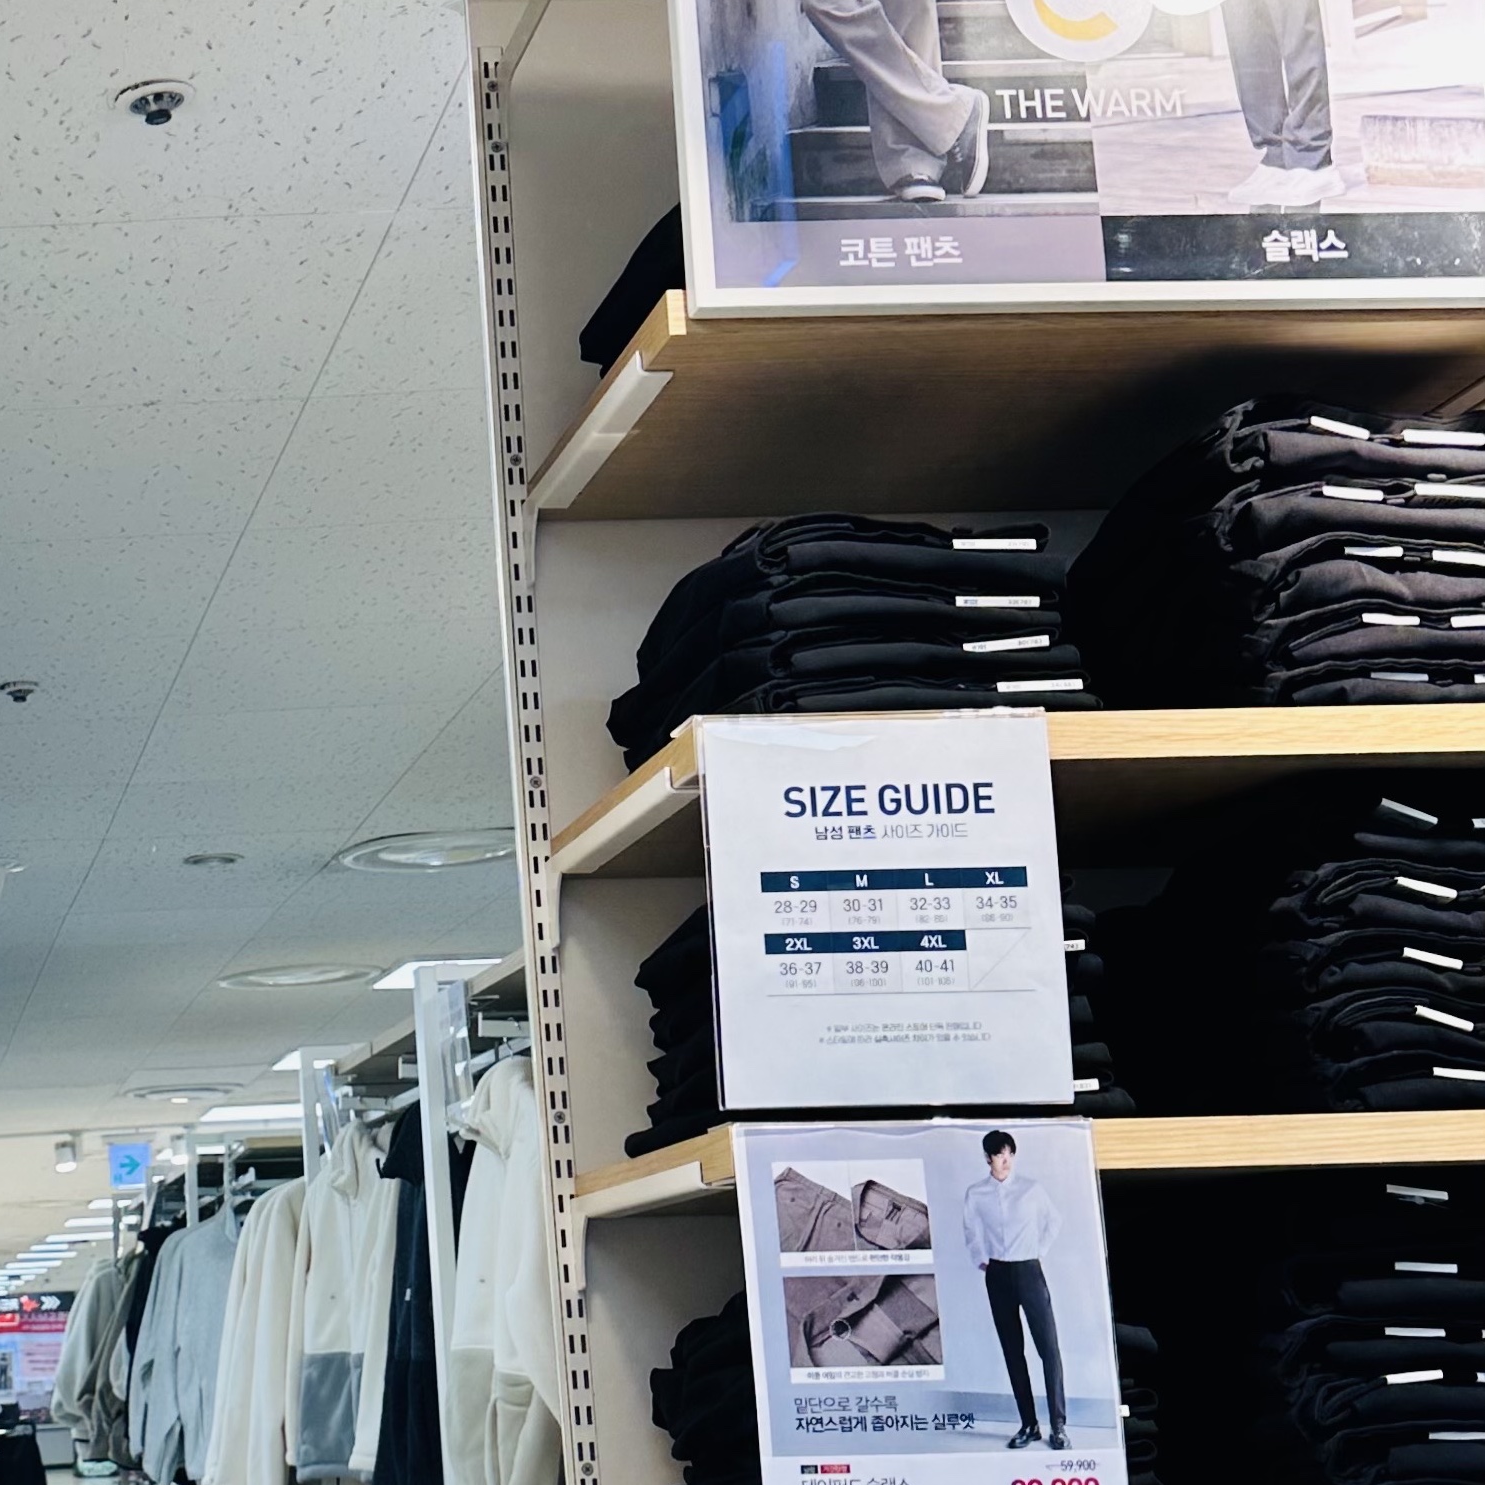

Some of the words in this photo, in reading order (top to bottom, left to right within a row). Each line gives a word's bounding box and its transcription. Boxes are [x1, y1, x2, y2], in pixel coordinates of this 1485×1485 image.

[995, 89, 1066, 119] THE
[1071, 87, 1187, 118] WARM
[839, 237, 896, 269] 코튼
[905, 234, 963, 267] 팬츠
[1262, 229, 1348, 263] 슬랙스
[783, 785, 868, 818] SIZE
[878, 782, 996, 816] GUIDE
[815, 826, 843, 841] 남성
[848, 825, 877, 840] 팬츠
[882, 824, 923, 839] 사이즈
[927, 823, 968, 838] 가이드
[790, 875, 801, 889] S
[855, 874, 868, 888] M
[924, 873, 934, 887] L
[985, 872, 1004, 885] XL
[773, 898, 818, 914] 28-29
[842, 897, 883, 912] 30-31
[910, 896, 951, 911] 32-33
[975, 895, 1017, 910] 34-35
[785, 937, 812, 951] 2XL
[852, 936, 880, 950] 3XL
[919, 934, 947, 949] 4XL
[779, 961, 822, 976] 36-37
[845, 960, 889, 975] 38-39
[914, 958, 955, 973] 40-41
[794, 1396, 852, 1413] 밑단으로
[855, 1395, 898, 1412] 갈수록
[795, 1415, 867, 1432] 자연스럽게
[871, 1413, 929, 1431] 좁아지는
[932, 1412, 975, 1430] 실루엣
[1060, 1459, 1096, 1473] 59,900
